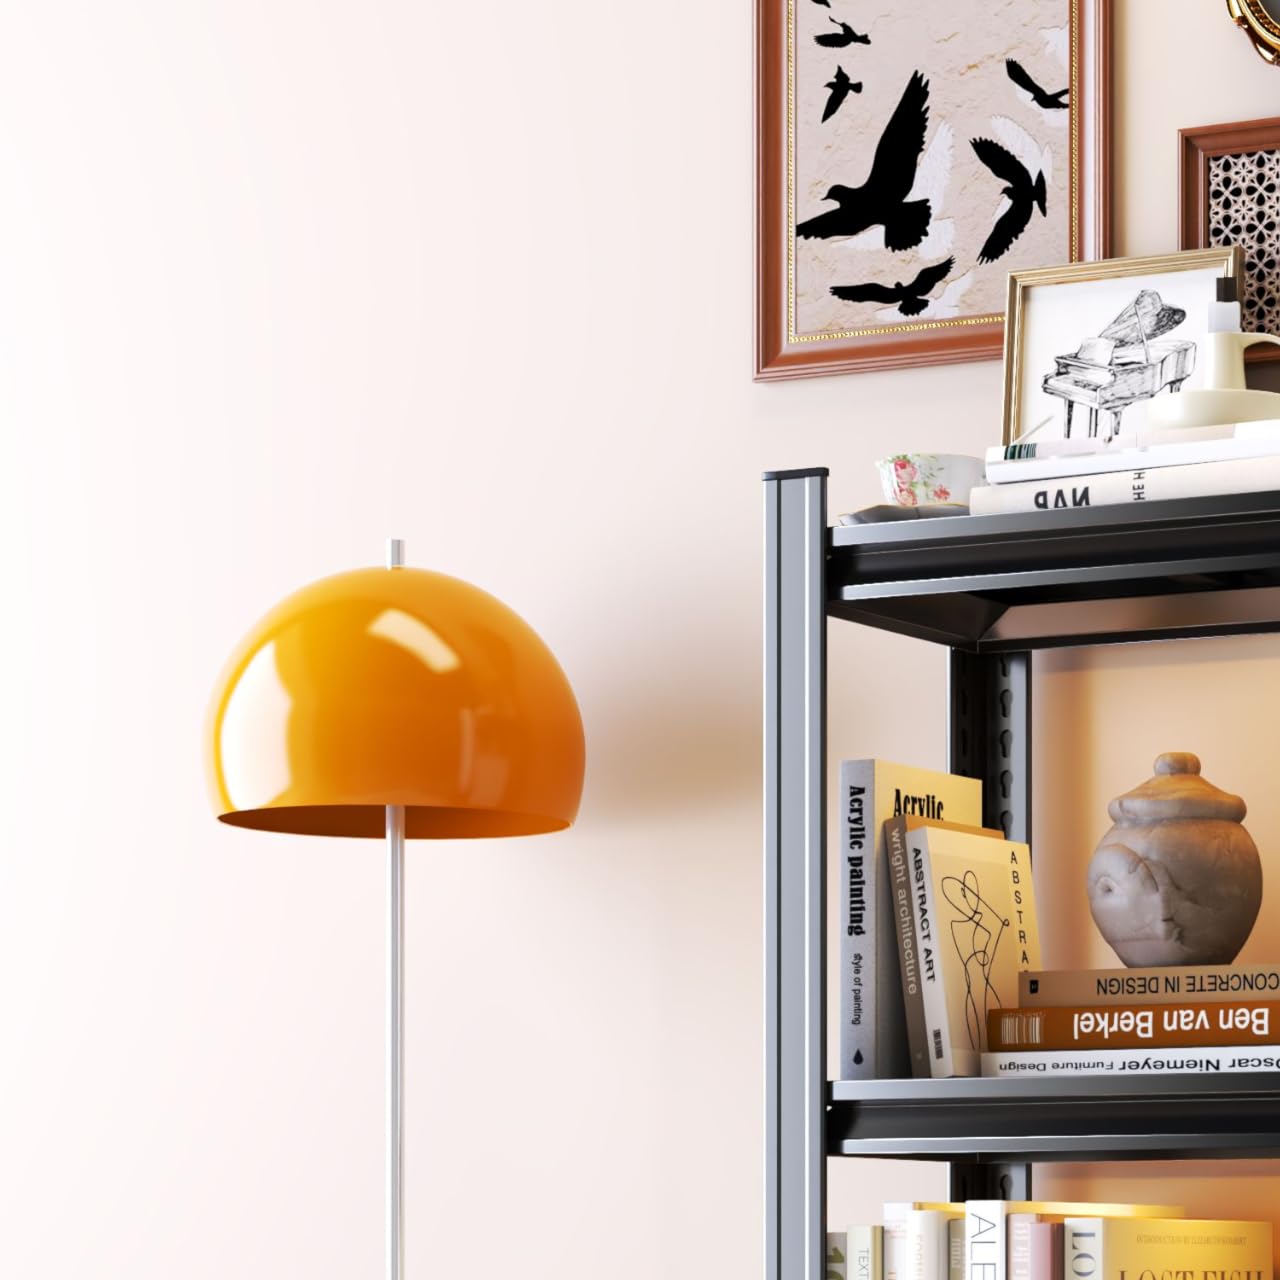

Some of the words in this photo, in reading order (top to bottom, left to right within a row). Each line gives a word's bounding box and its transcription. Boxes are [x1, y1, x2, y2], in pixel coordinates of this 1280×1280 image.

[848, 785, 866, 850] Acrylic
[888, 828, 911, 884] wright
[847, 855, 866, 937] painting
[911, 846, 932, 943] ABSTRACT
[924, 947, 936, 982] ART
[1009, 850, 1030, 972] ABSTRA
[895, 889, 919, 996] architecture
[851, 952, 865, 976] style
[851, 976, 865, 988] of
[1096, 976, 1159, 996] DESIGN
[1164, 976, 1180, 993] IN
[1186, 972, 1280, 993] CONCRETE
[851, 989, 863, 1026] painting
[1219, 1007, 1269, 1035] Ben
[1073, 1010, 1154, 1040] Berkel
[1163, 1009, 1211, 1035] van
[998, 1060, 1047, 1073] Design
[1051, 1061, 1114, 1071] Furniture
[1118, 1055, 1221, 1073] Niemeyer
